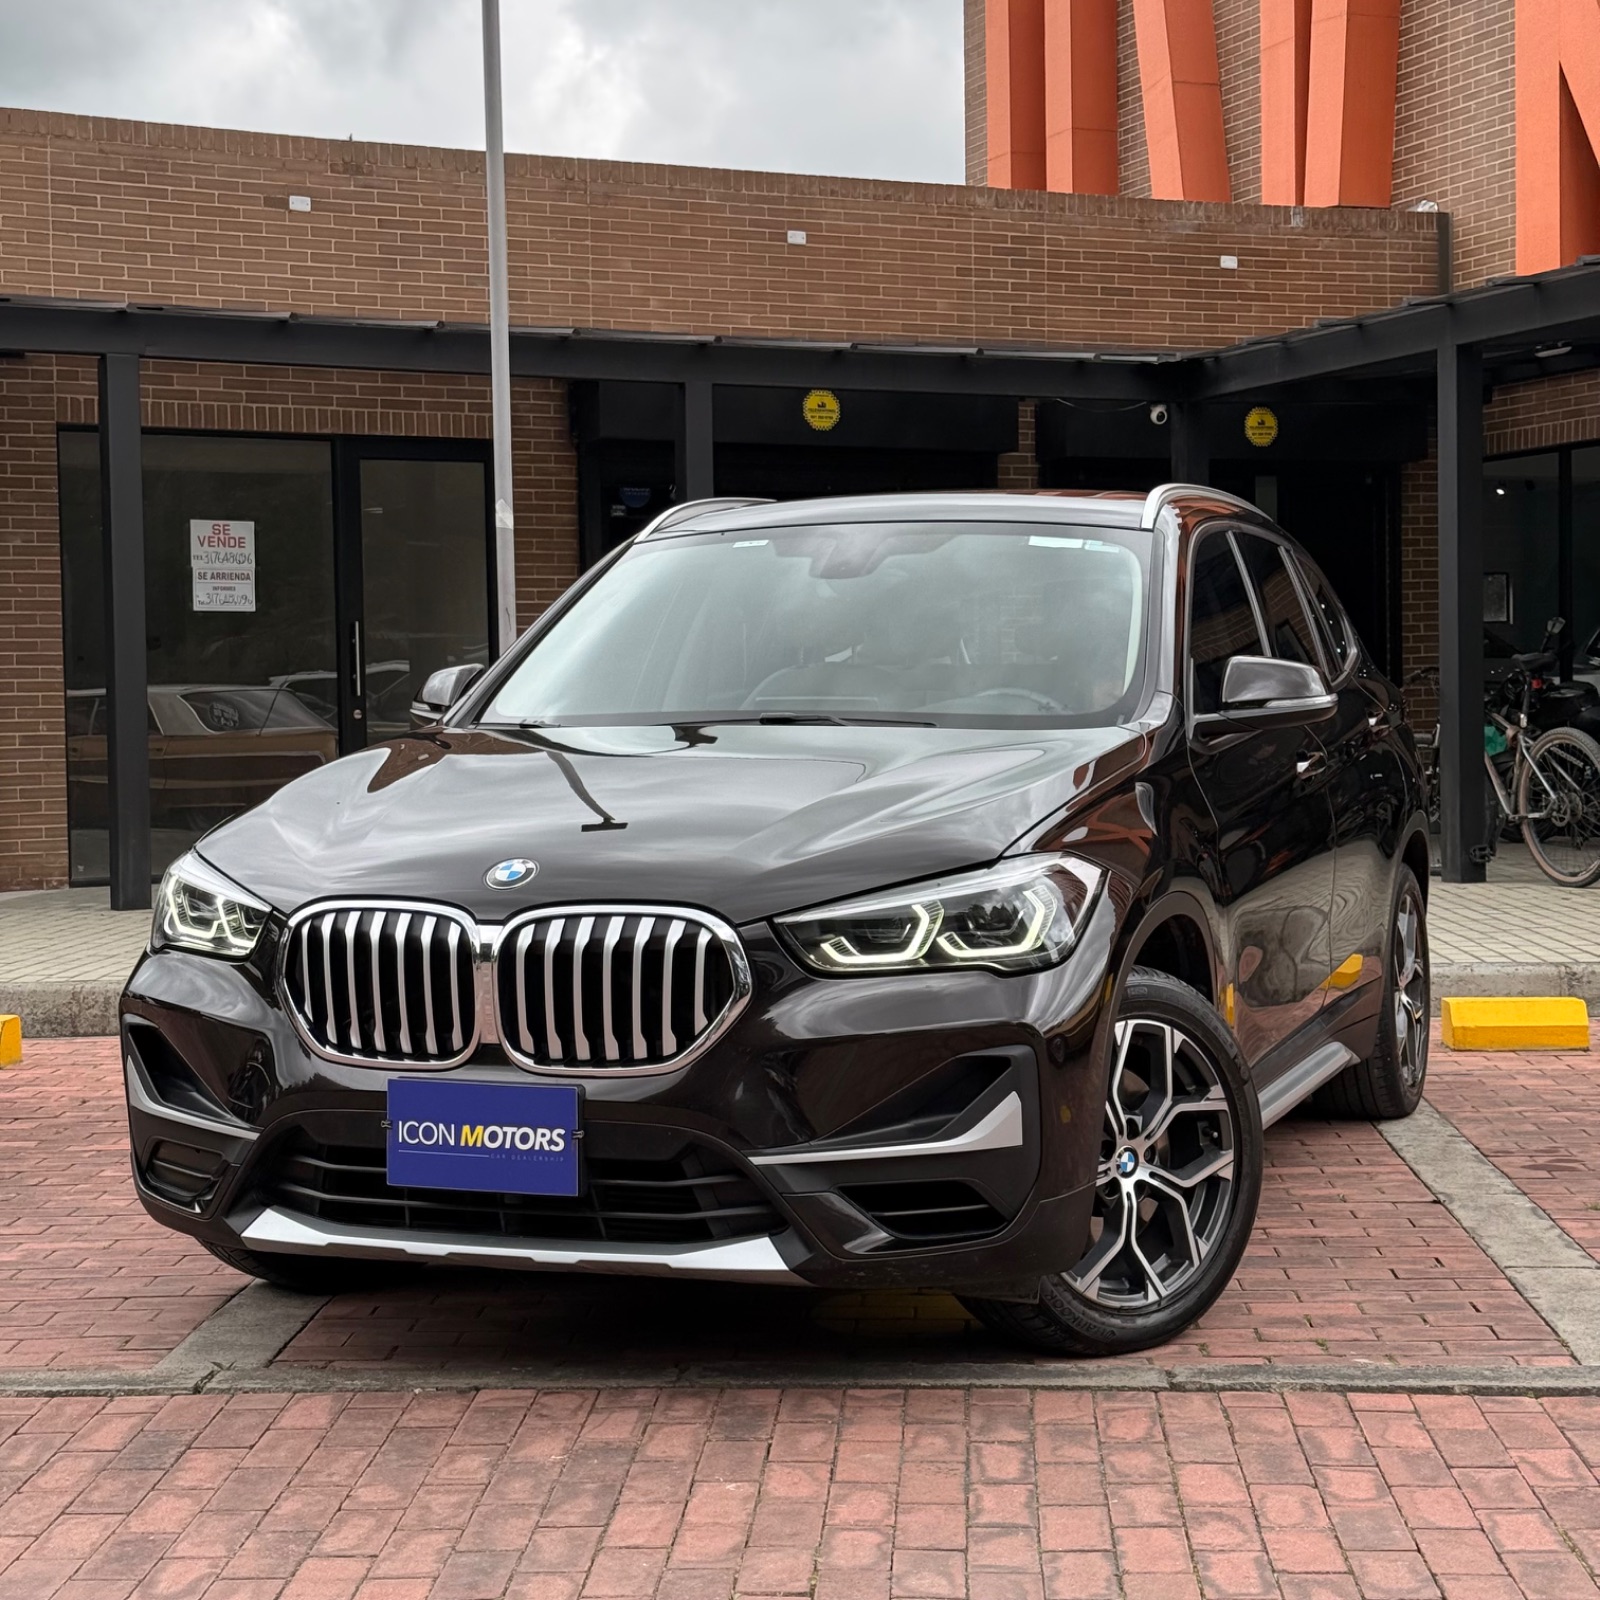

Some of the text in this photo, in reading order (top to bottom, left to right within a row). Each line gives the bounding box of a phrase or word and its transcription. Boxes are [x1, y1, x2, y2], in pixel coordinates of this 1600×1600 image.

[212, 523, 231, 536] SE
[197, 535, 246, 549] VENDE
[197, 571, 252, 582] SE ARRIENDA
[398, 1120, 566, 1152] ICON MOTORS
[511, 1155, 564, 1163] DEALERSHIP
